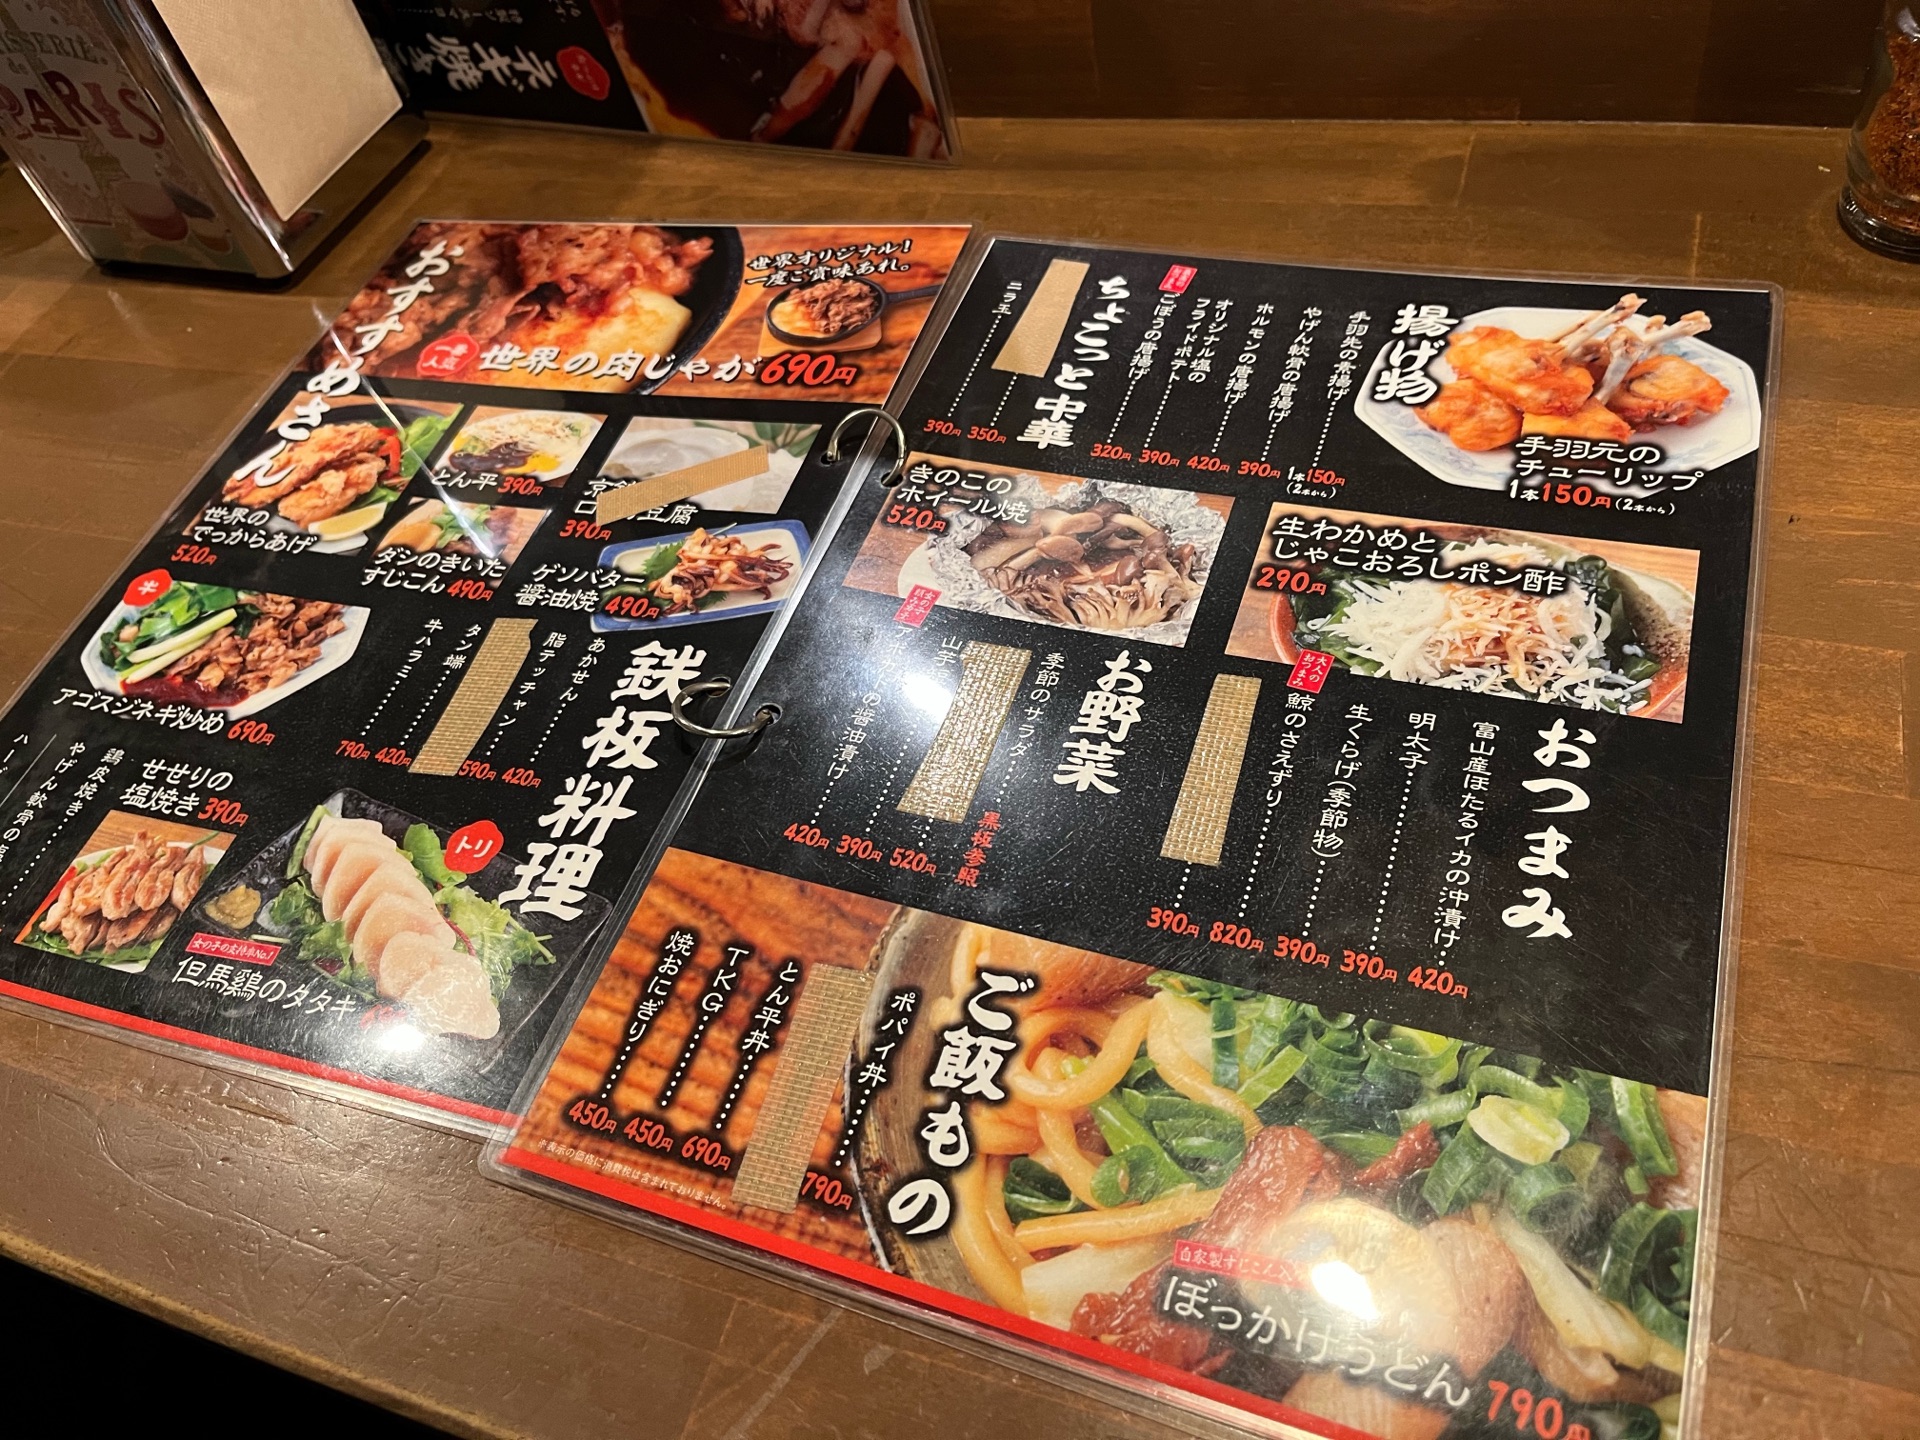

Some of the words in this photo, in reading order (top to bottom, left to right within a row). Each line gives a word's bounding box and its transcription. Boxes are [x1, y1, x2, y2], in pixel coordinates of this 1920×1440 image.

[747, 258, 911, 287] 一度ご賞味あれ。
[750, 239, 913, 271] 世界オリジナル!
[991, 279, 1023, 315] ニラ玉
[1128, 293, 1181, 380] ごぼうの唐揚げ
[1168, 297, 1211, 383] フライドポテト
[1188, 299, 1234, 383] オリジナル塩の
[1224, 302, 1275, 405] ホルモンの唐揚げ
[1373, 302, 1460, 404] 揚げ物
[232, 240, 465, 489] おすすめさん
[478, 346, 762, 383] 世界の肉じゃが
[759, 352, 858, 387] 690円
[1016, 275, 1131, 450] ちょこっと中華
[1268, 306, 1323, 423] やげん軟骨の唐揚げ
[1326, 310, 1371, 401] 手羽先の素揚げ
[923, 419, 962, 437] 390円
[966, 427, 1006, 444] 350円
[1090, 443, 1133, 461] 320円
[1138, 449, 1181, 467] 390円
[1186, 455, 1231, 473] 420円
[1515, 435, 1662, 465] 手羽元の
[432, 471, 498, 490] とん平
[498, 475, 543, 497] 390円
[908, 463, 1012, 495] きのこの
[1237, 460, 1281, 479] 390円
[1515, 458, 1705, 492] チューリップ
[204, 506, 270, 526] 世界の
[886, 505, 947, 533] 520円
[896, 484, 1029, 525] ホイール焼
[193, 524, 316, 555] でっからあげ
[559, 518, 612, 541] 390円
[1272, 516, 1437, 554] 生わかめと
[170, 545, 218, 566] 520円
[374, 546, 506, 577] ダシのきいた
[1274, 538, 1567, 593] じゃこおろしポン酢
[361, 566, 446, 594] すじこん
[447, 579, 494, 601] 490円
[531, 563, 646, 588] ゲソバター
[1256, 567, 1328, 596] 290円
[515, 583, 601, 614] 醤油焼
[604, 595, 660, 620] 490円
[396, 618, 443, 679] 牛ハラミ
[498, 631, 567, 728] 脂テッチャン
[559, 637, 606, 702] あかせん
[1311, 656, 1328, 683] 大人の
[52, 687, 226, 735] アゴスジネギ炒め
[227, 719, 276, 746] 690円
[1009, 652, 1065, 759] 季節のサラダ
[1051, 649, 1154, 795] お野菜
[335, 740, 371, 760] 790円
[374, 748, 412, 767] 420円
[1265, 692, 1317, 808] 鯨のさえずり
[1398, 713, 1437, 769] 明太子
[65, 747, 126, 817] 鶏皮焼き
[142, 758, 234, 791] せせりの
[458, 764, 497, 781] 590円
[500, 639, 708, 922] 鉄板料理
[501, 767, 542, 788] 420円
[119, 783, 200, 817] 塩焼き
[198, 797, 249, 827] 390円
[783, 822, 830, 849] 420円
[1433, 721, 1501, 949] 富山産ほたるイカの沖漬け
[1501, 717, 1598, 940] おつまみ
[457, 835, 494, 858] トリ
[835, 834, 883, 863] 390円
[889, 847, 938, 876] 520円
[953, 811, 1002, 888] 黒板参照
[1146, 906, 1202, 938] 390円
[1209, 921, 1265, 953] 820円
[1273, 935, 1331, 968] 390円
[1340, 949, 1398, 983] 390円
[628, 929, 695, 1043] 焼おにぎり
[1407, 965, 1469, 999] 420円
[742, 961, 799, 1053] とん平丼
[858, 991, 917, 1086] ポパイ丼
[568, 1100, 618, 1134] 450円
[888, 971, 1035, 1235] ご飯もの
[623, 1118, 674, 1153] 450円
[681, 1135, 732, 1172] 690円
[800, 1170, 853, 1211] 790円
[1163, 1275, 1470, 1406] ぼっかけうどん
